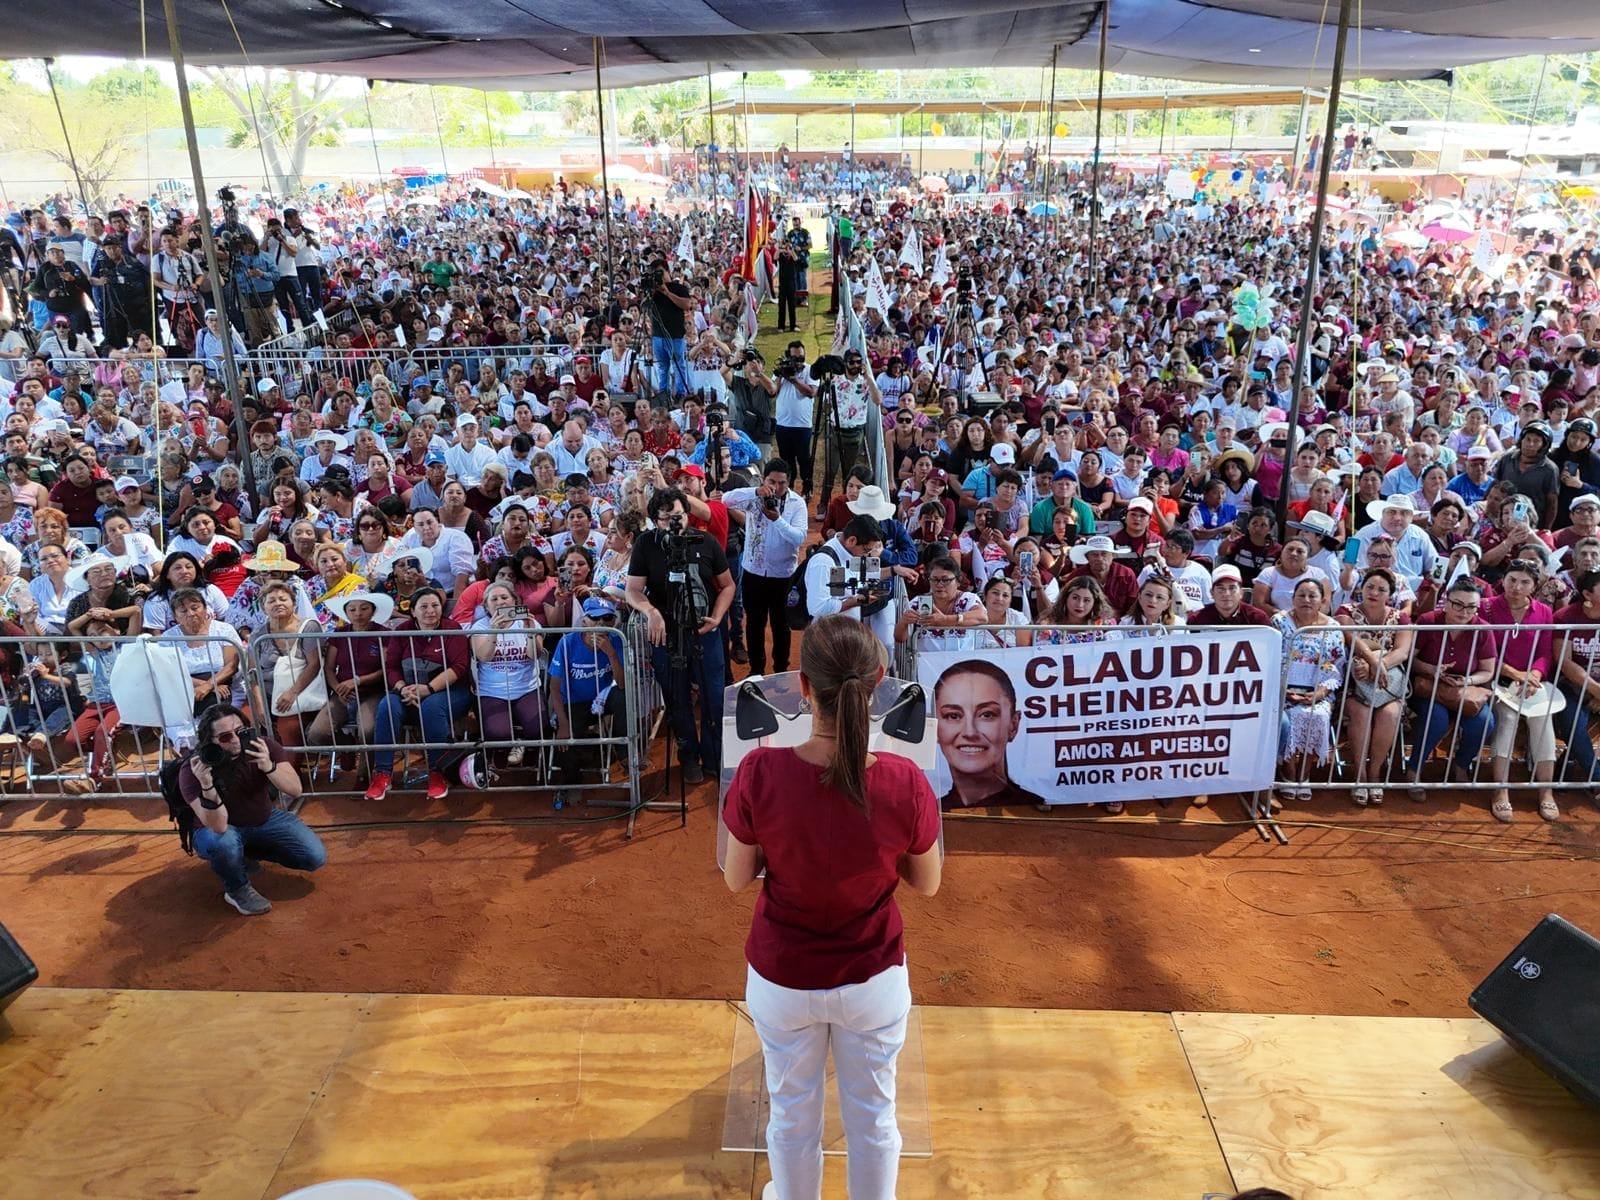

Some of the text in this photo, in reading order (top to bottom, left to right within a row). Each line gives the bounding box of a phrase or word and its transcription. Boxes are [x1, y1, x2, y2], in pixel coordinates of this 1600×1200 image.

[1025, 640, 1261, 689] CLAUDIA
[1024, 679, 1263, 719] SHEINBAUM
[1084, 714, 1200, 733] PRESIDENTA
[1057, 735, 1229, 762] AMOR AL PUEBLO
[1056, 761, 1229, 786] AMOR POR TICUL
